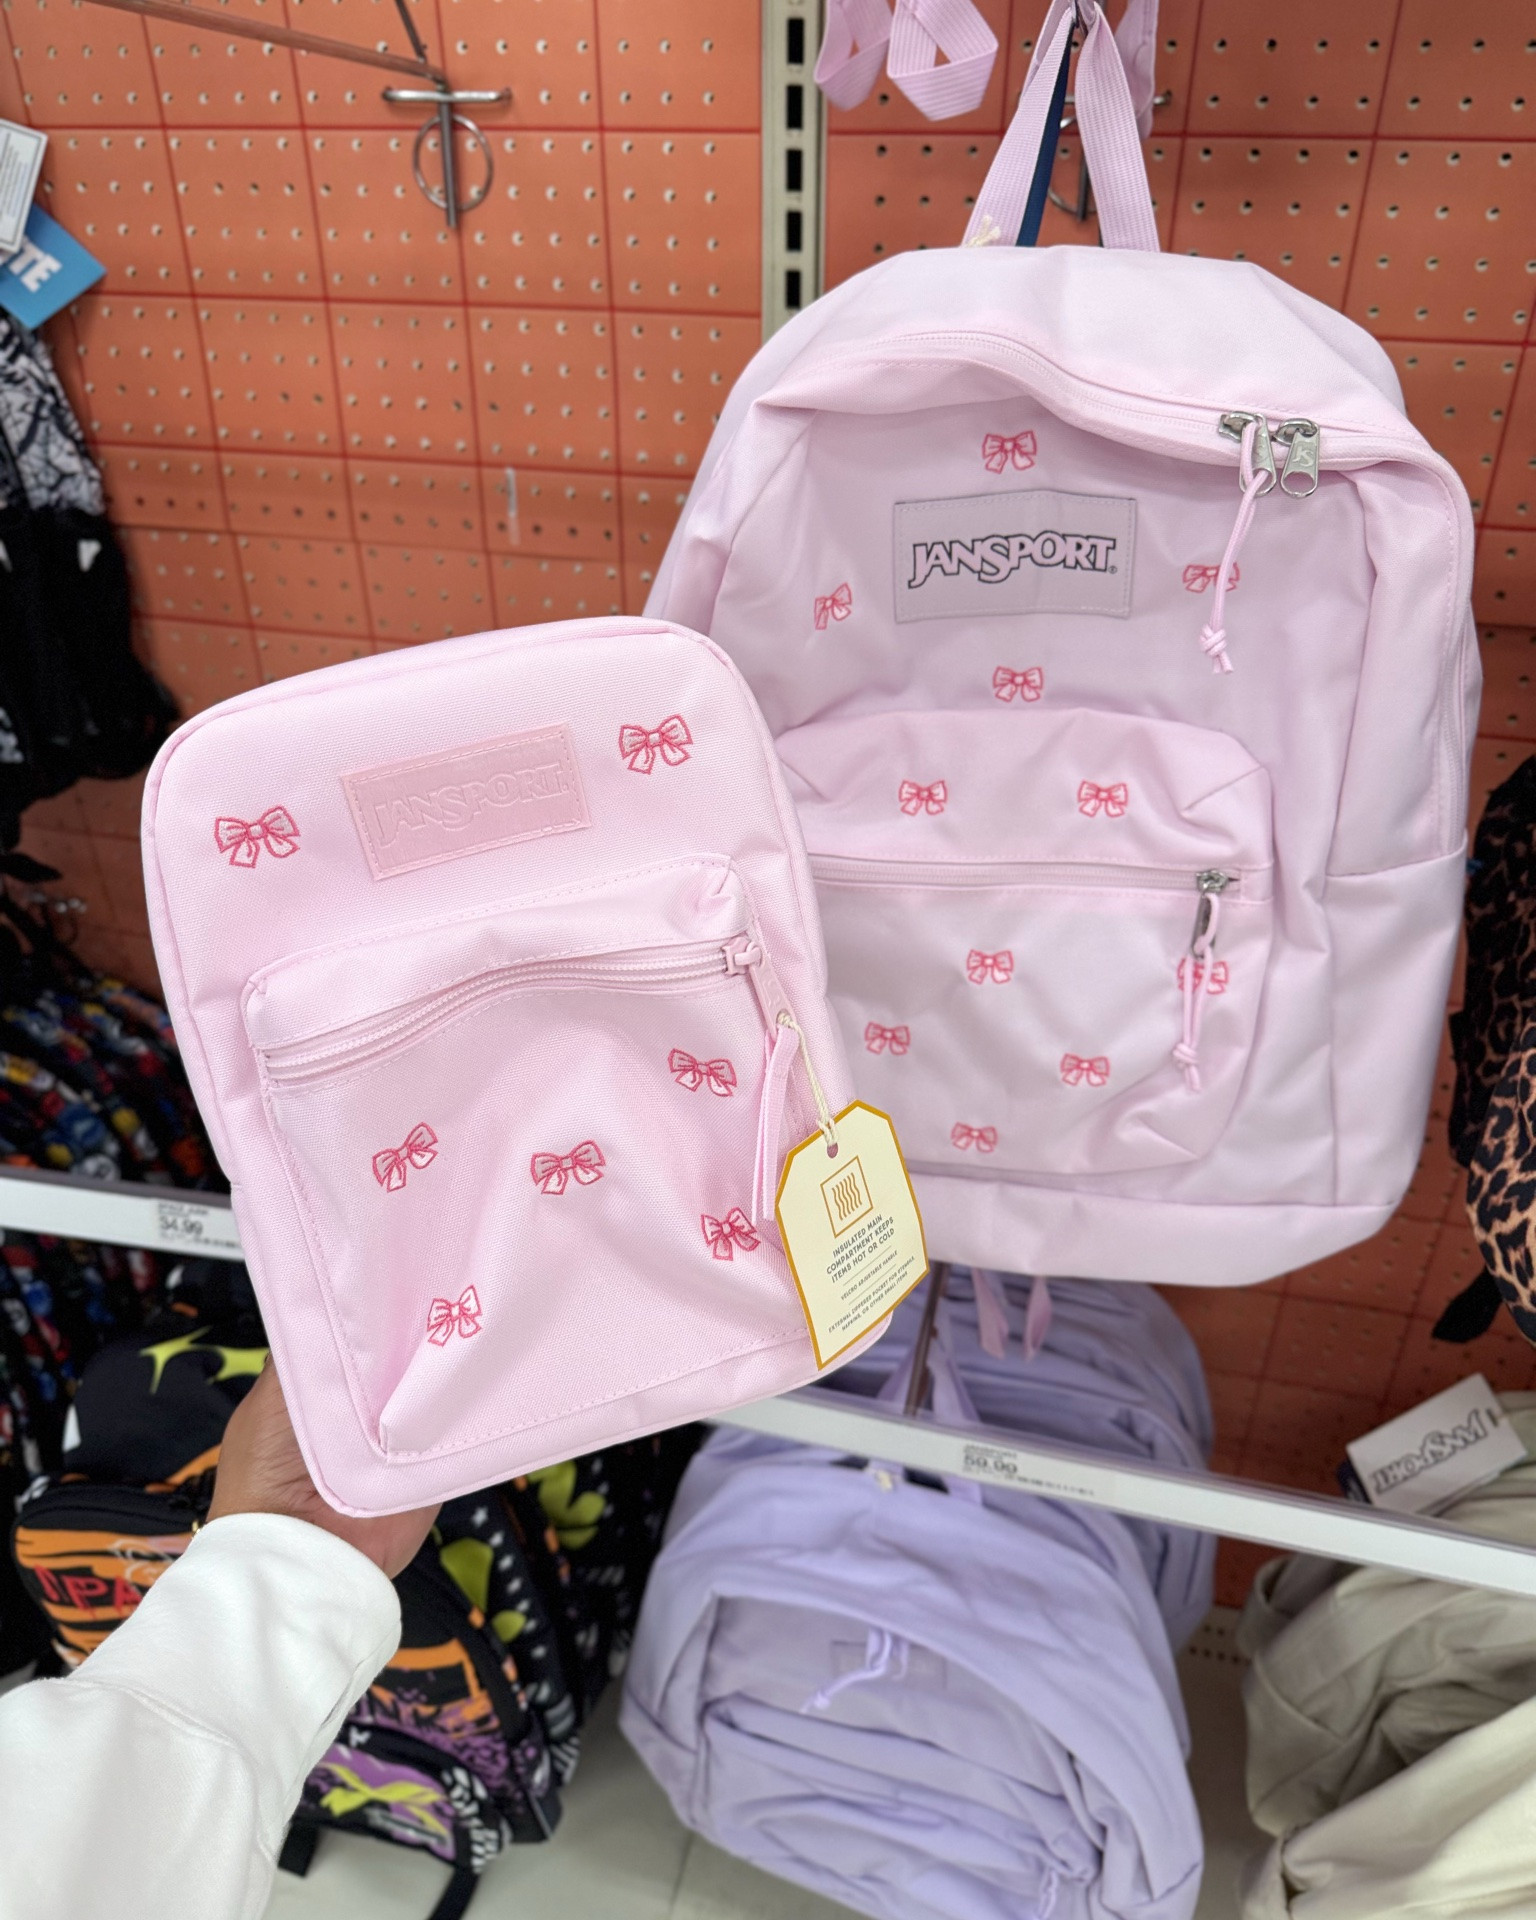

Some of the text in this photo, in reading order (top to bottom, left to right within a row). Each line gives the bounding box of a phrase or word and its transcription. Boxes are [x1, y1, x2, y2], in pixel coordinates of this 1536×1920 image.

[0, 236, 63, 293] TE
[907, 530, 1117, 590] JANSPORT
[373, 762, 565, 849] JANSPORT
[826, 1216, 894, 1275] COMPARTMENT KEEPS
[831, 1228, 895, 1283] ITEMS HOT OR COLD
[832, 1214, 883, 1258] INSULATED MAIN
[841, 1250, 898, 1301] VELCRO ADJUSTABLE HANDLE
[828, 1312, 851, 1333] EXTERNAL
